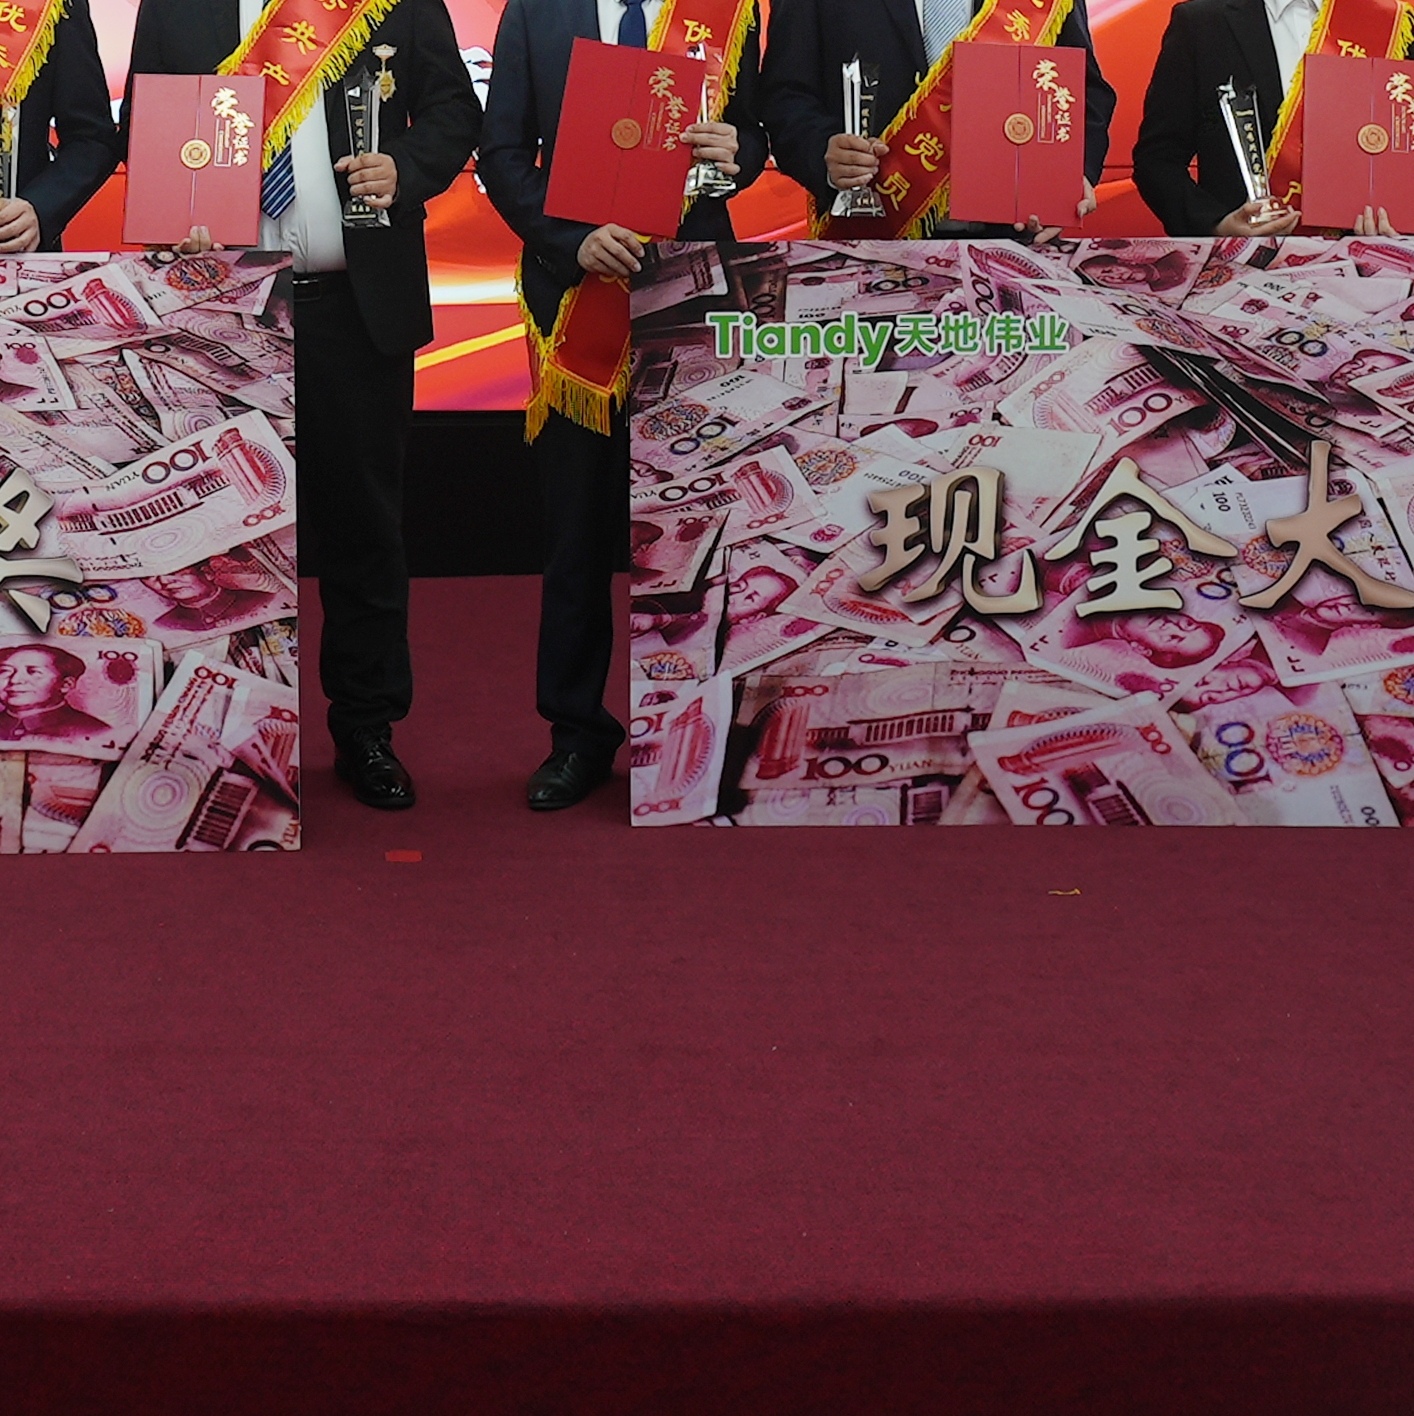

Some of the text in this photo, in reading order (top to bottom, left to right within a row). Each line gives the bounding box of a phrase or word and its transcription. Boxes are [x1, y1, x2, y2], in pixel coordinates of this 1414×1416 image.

[876, 132, 945, 211] 党员
[23, 287, 83, 317] 100
[706, 314, 1068, 366] Tiandy 天地伟业
[1263, 328, 1328, 358] 100
[1109, 393, 1172, 436] 100
[969, 435, 1004, 447] 100
[142, 440, 212, 484] 100
[657, 471, 726, 500] 100
[1213, 493, 1231, 512] 100
[97, 650, 138, 662] 100
[194, 666, 236, 689] 100
[1139, 723, 1172, 755] 100
[801, 753, 890, 781] 100
[1016, 780, 1075, 827] 100
